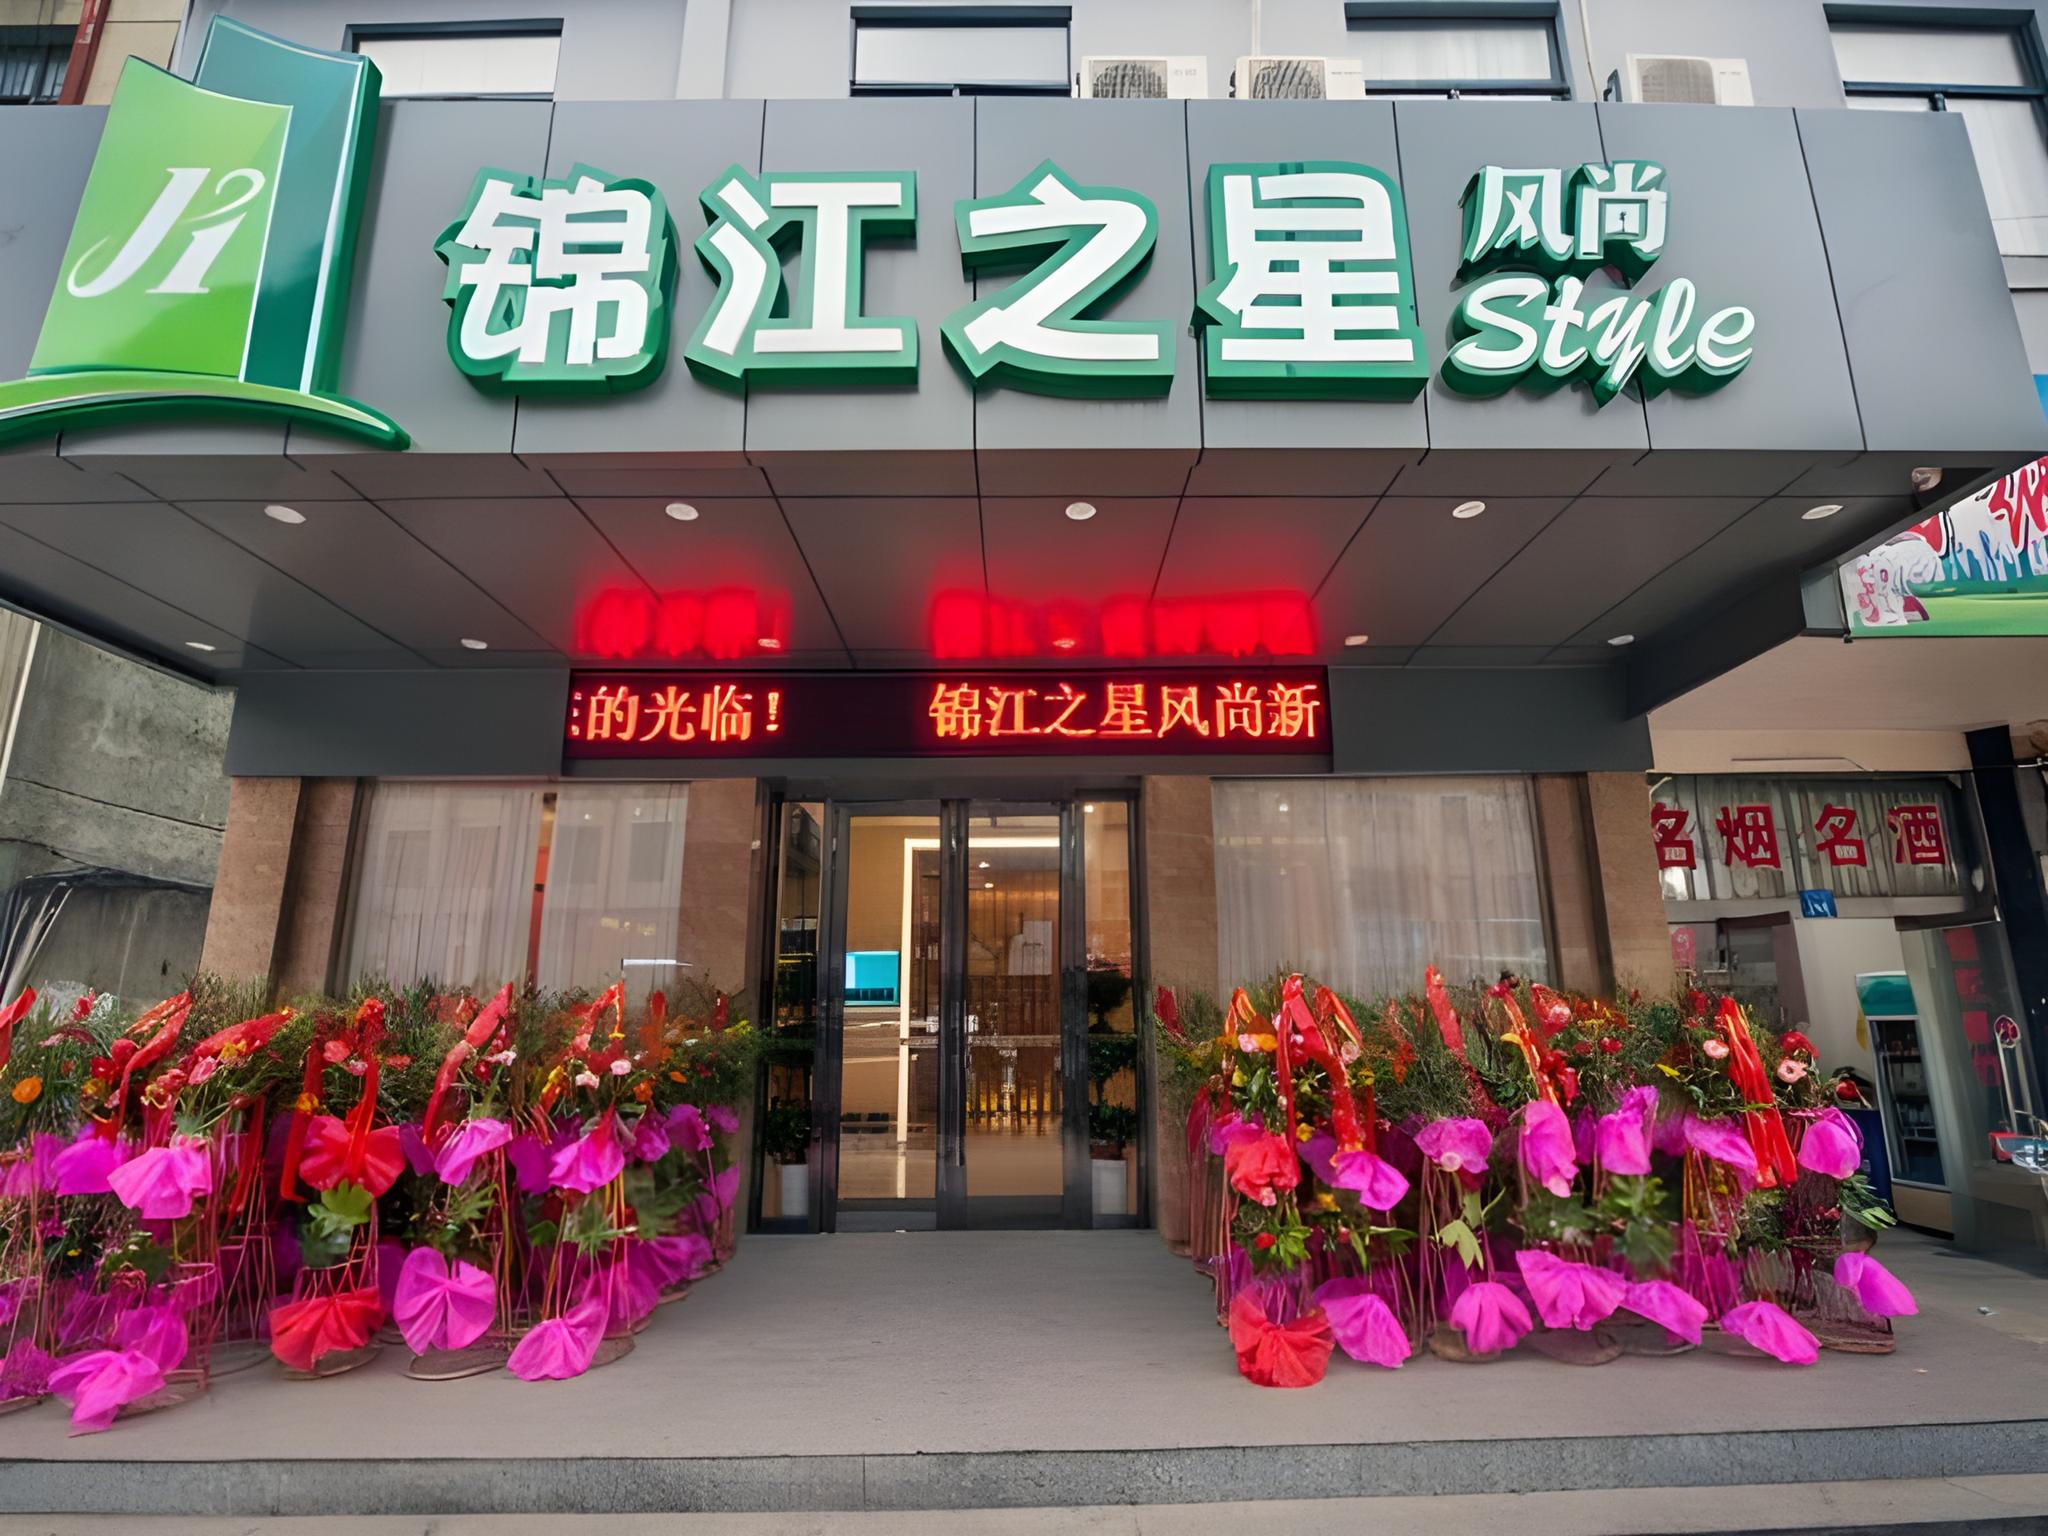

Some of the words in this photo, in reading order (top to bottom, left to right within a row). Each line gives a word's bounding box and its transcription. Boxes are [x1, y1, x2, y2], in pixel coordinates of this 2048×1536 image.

[1470, 164, 1668, 260] 风尚
[448, 168, 1418, 370] 锦江之星
[1452, 276, 1755, 398] Style
[928, 683, 1321, 739] 锦江之星风尚新
[1651, 802, 1946, 870] 名烟名酒
